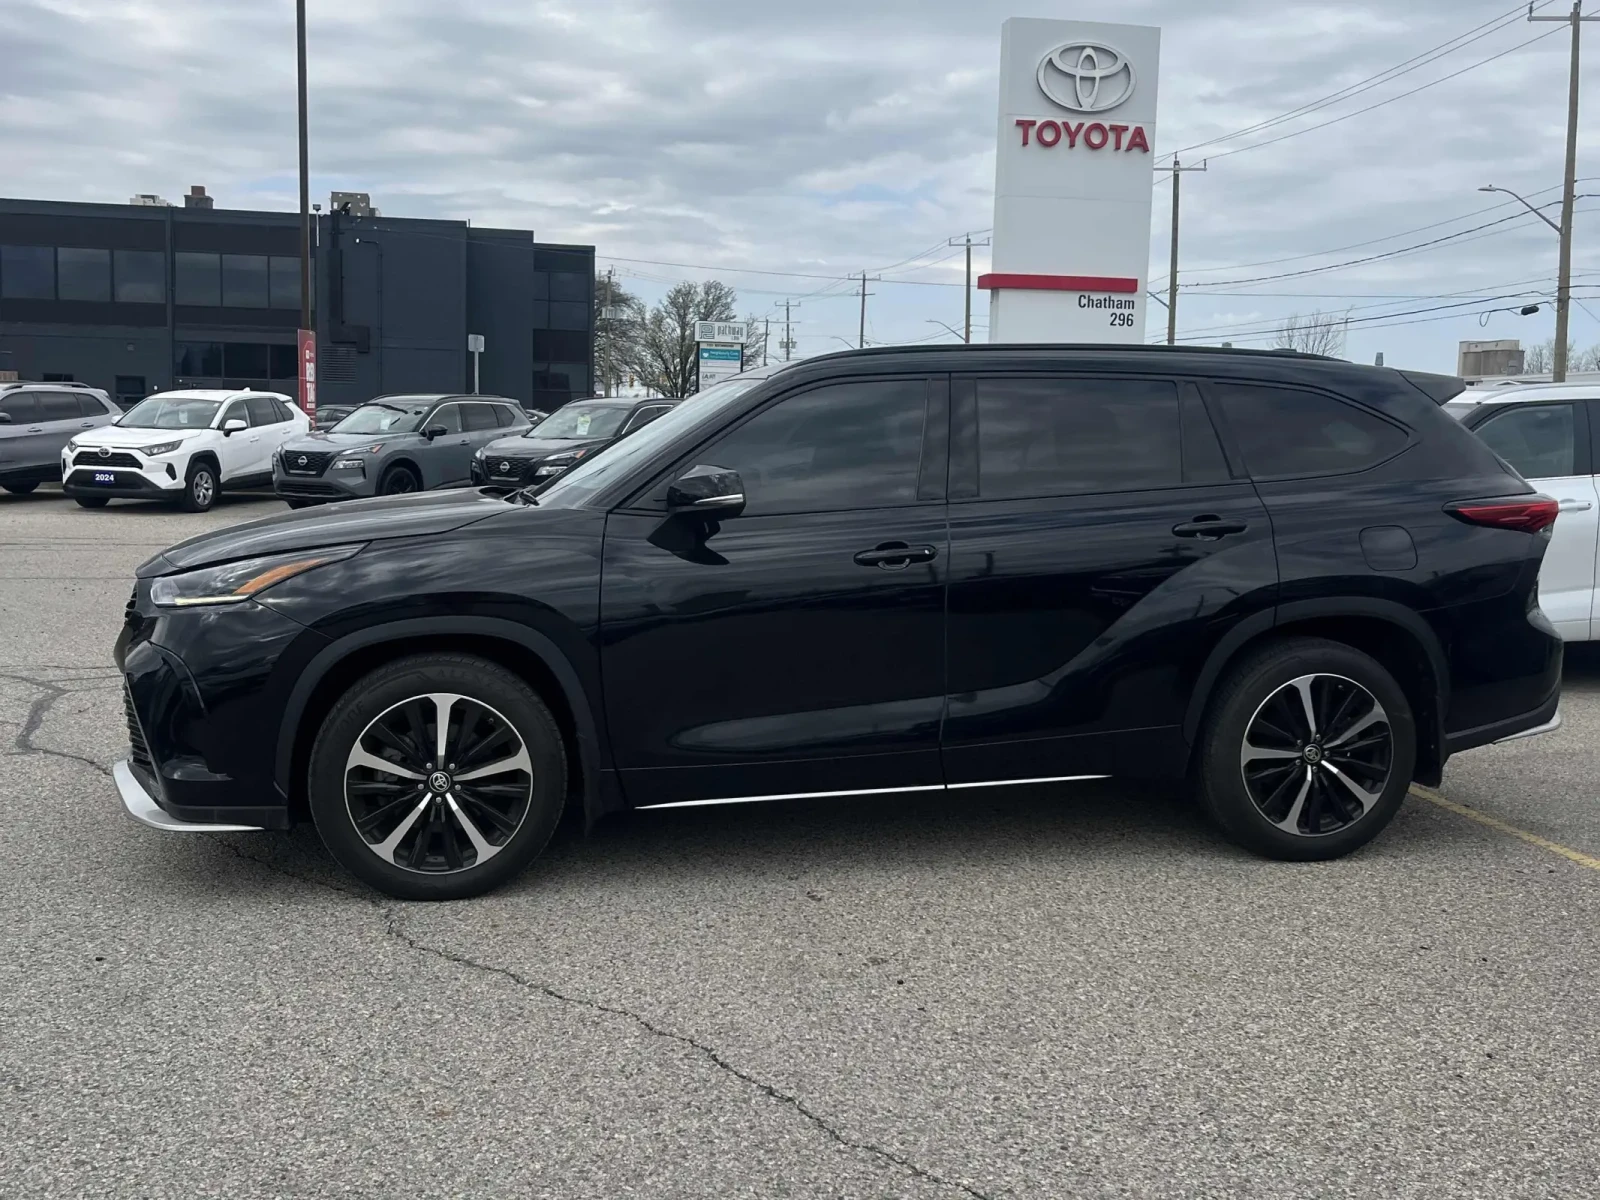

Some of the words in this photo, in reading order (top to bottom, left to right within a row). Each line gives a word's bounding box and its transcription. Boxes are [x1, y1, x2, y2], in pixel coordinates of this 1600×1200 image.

[1015, 119, 1150, 153] TOYOTA
[1078, 294, 1135, 310] Chatham
[1109, 312, 1134, 327] 296
